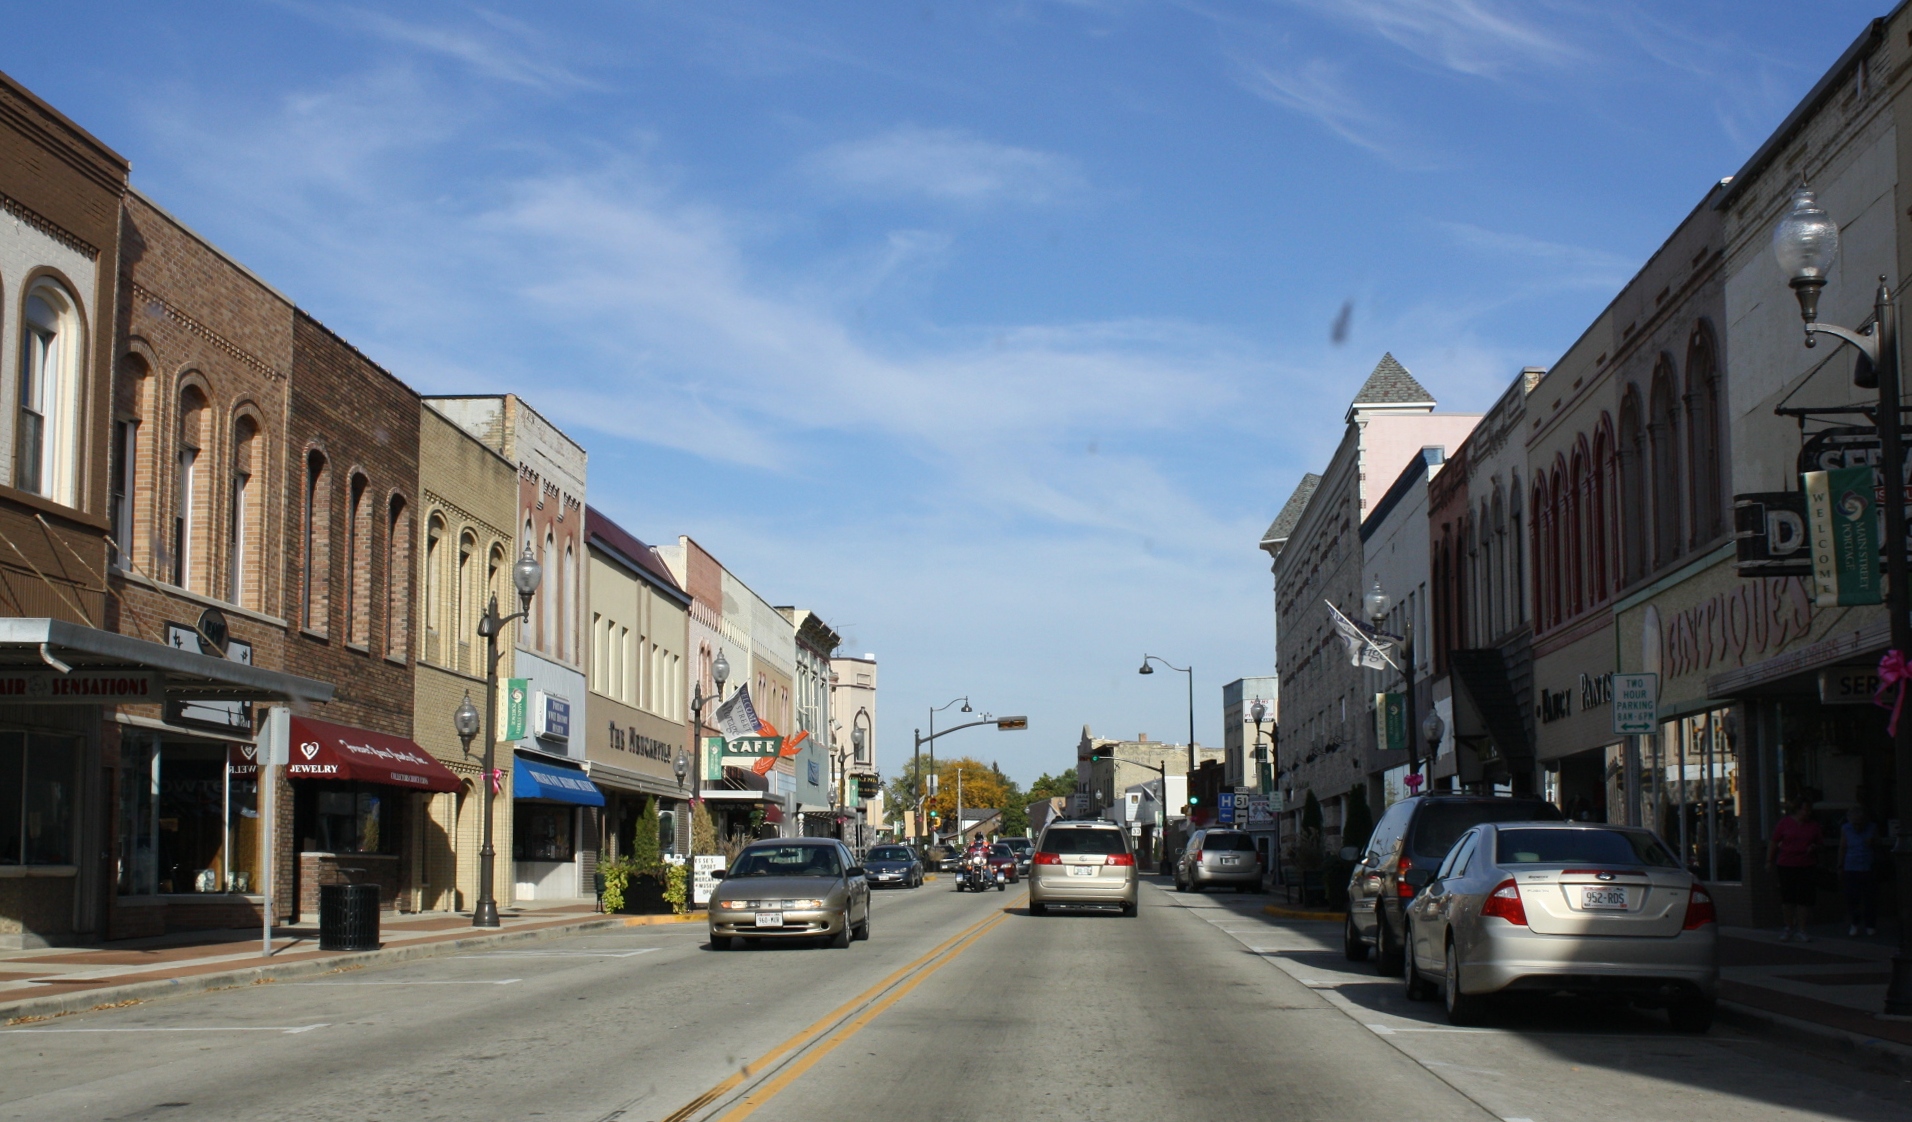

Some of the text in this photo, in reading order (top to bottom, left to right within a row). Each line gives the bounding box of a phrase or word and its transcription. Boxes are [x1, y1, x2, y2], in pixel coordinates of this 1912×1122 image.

[1812, 493, 1831, 594] WELCOME
[1842, 523, 1855, 572] PORTAGE
[1855, 522, 1869, 589] MAIN STREET
[51, 678, 148, 695] SENSATIONS
[1626, 679, 1643, 688] TWO
[1623, 690, 1647, 699] HOUR
[1616, 701, 1654, 710] PARKING
[608, 720, 625, 751] THE
[629, 726, 671, 764] MERCANTILE
[728, 740, 775, 753] CAFE
[289, 764, 339, 774] JEWELRY
[1221, 796, 1231, 807] H
[1236, 797, 1247, 806] 51
[1586, 891, 1625, 904] 952-RDS
